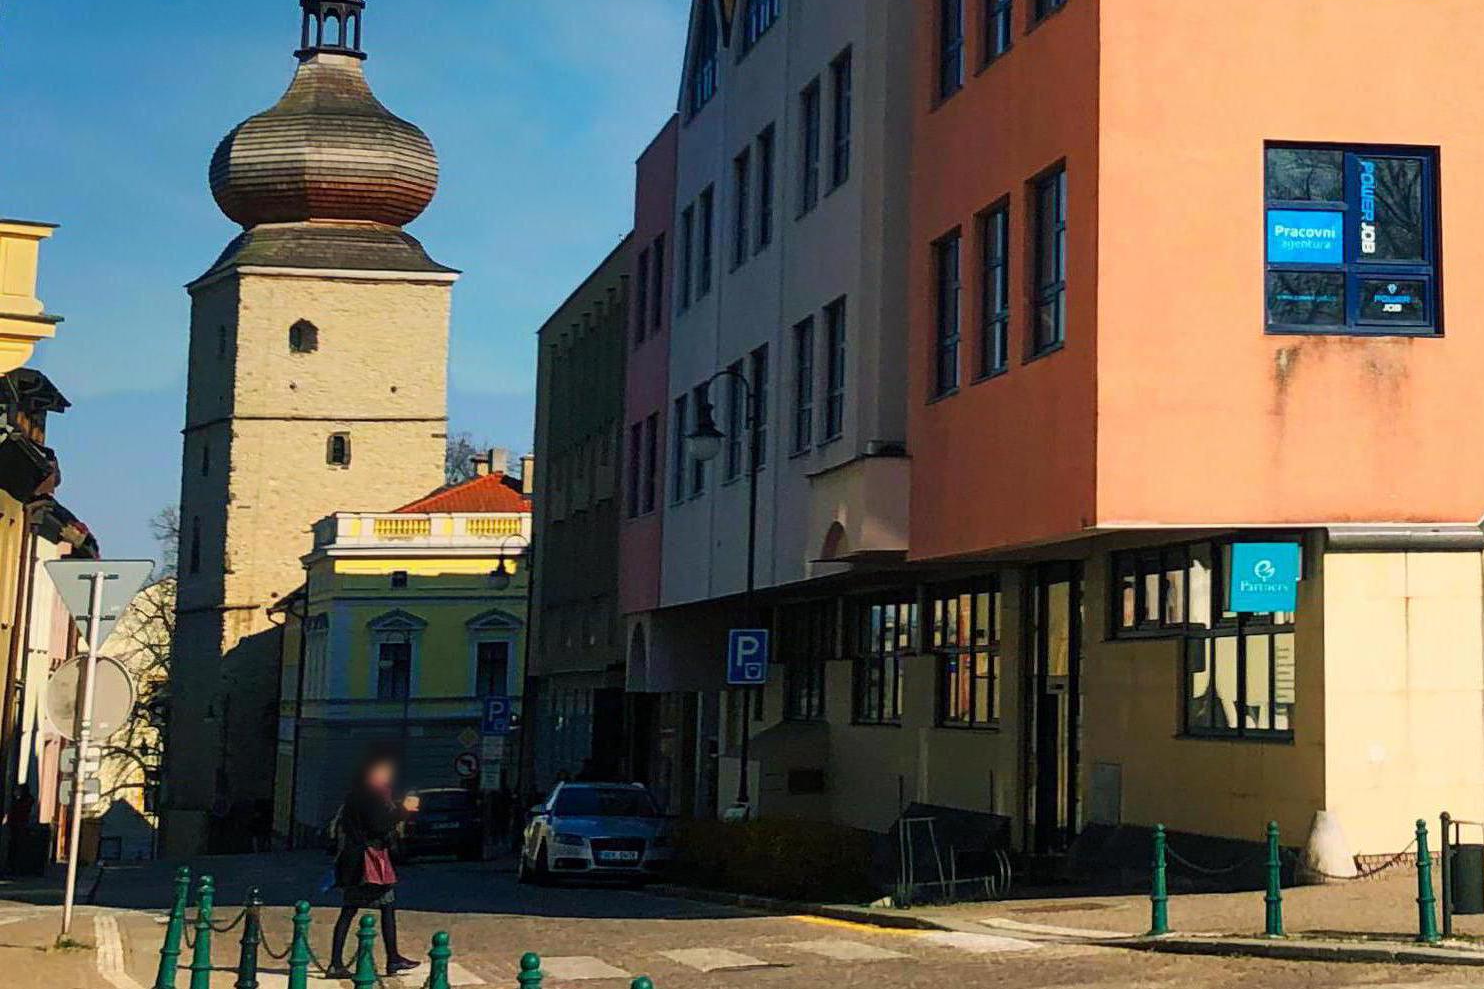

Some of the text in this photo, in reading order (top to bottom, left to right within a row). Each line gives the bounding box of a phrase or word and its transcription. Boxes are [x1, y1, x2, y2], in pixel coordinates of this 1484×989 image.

[1360, 160, 1376, 254] POWER JOB
[1281, 238, 1331, 250] agentura
[1240, 580, 1288, 592] Partners
[736, 636, 760, 666] P
[489, 701, 505, 722] P
